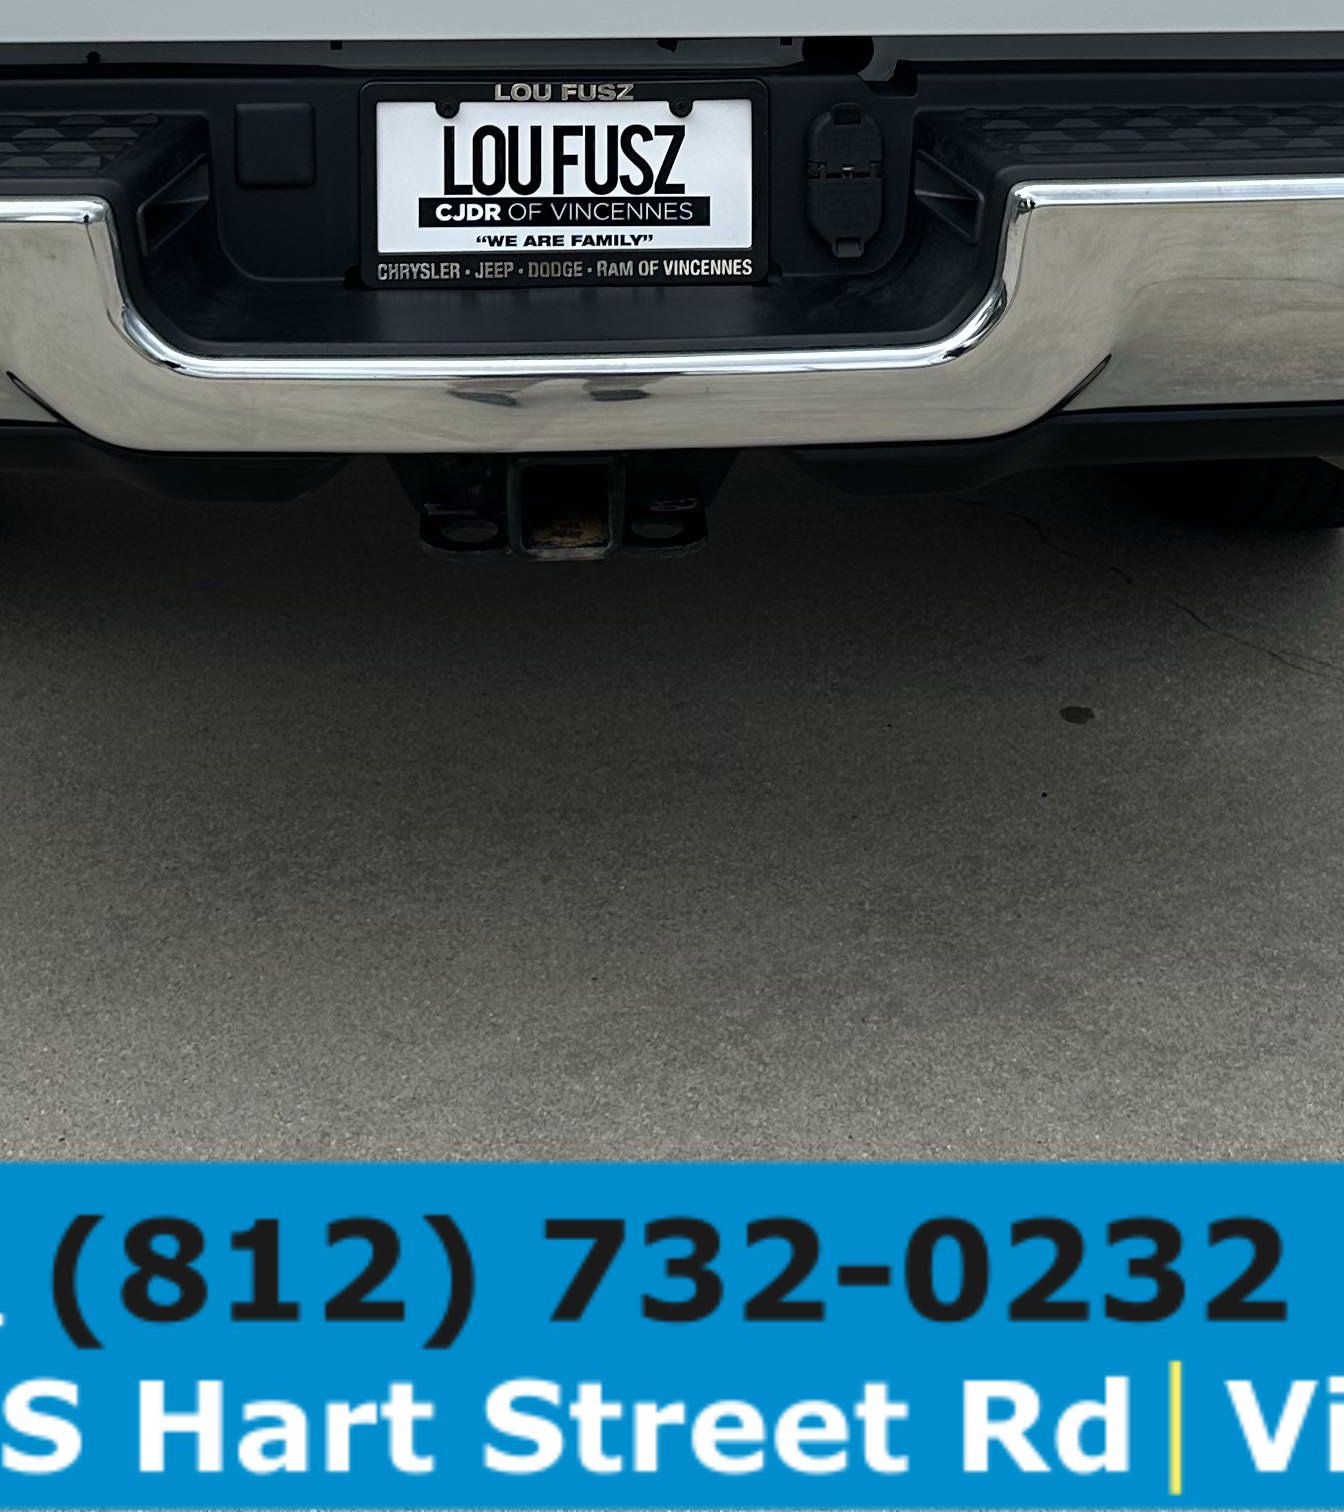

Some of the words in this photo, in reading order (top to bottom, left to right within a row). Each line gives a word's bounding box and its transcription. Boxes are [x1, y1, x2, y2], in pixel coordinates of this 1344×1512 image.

[495, 83, 552, 101] LOU
[561, 82, 635, 101] FUSZ
[443, 124, 542, 196] LOU
[553, 124, 685, 195] FUSZ
[436, 203, 501, 222] CJDR
[508, 202, 543, 221] OF
[550, 201, 693, 221] VINCENNES
[523, 235, 565, 247] ARE
[377, 262, 460, 280] CHRYSLER
[475, 261, 514, 278] JEEP
[528, 260, 583, 277] DODGE
[597, 260, 634, 277] RAM
[638, 259, 659, 276] OF
[662, 259, 753, 276] VINCENNES
